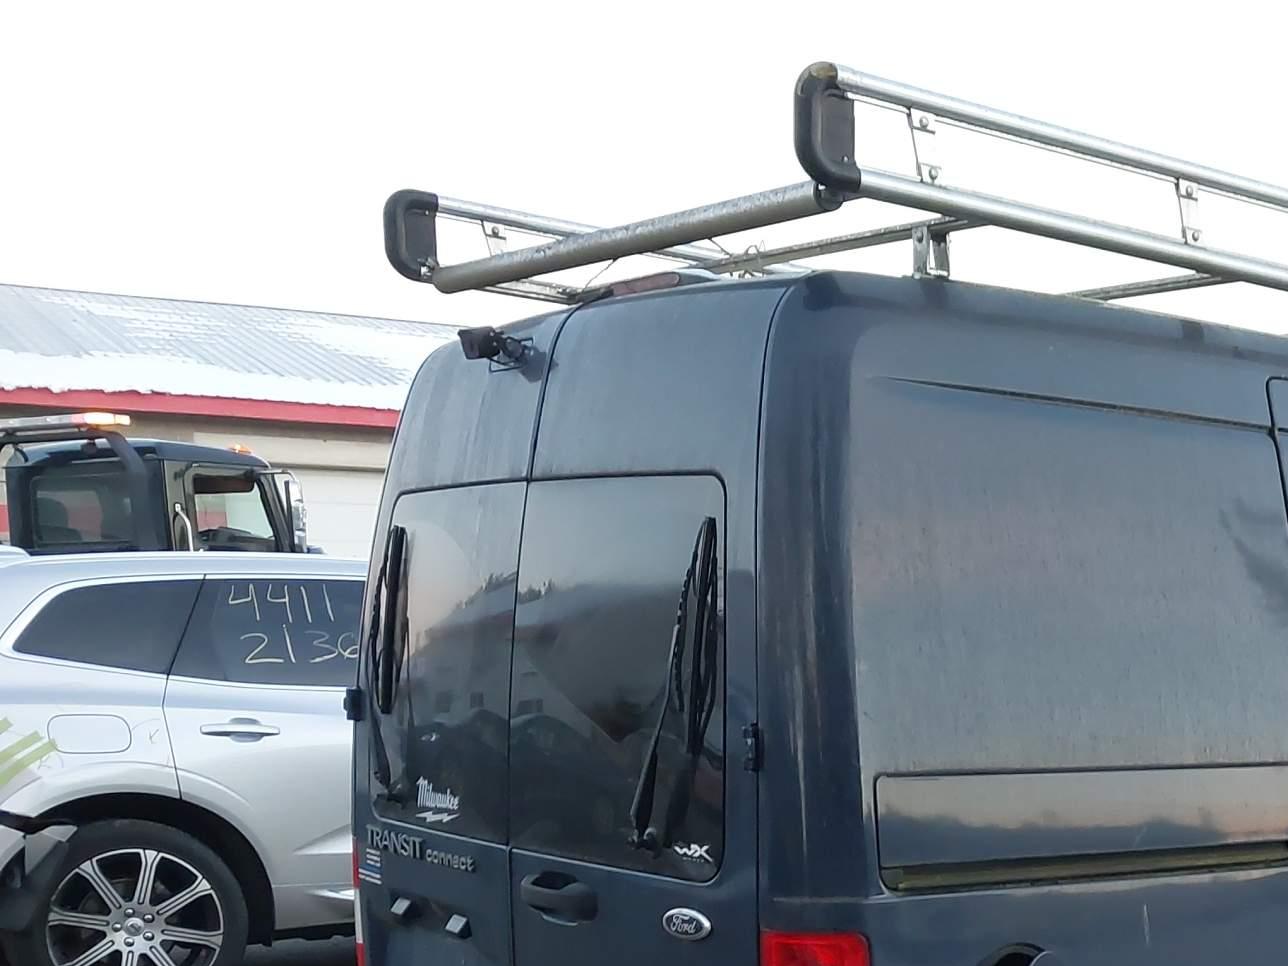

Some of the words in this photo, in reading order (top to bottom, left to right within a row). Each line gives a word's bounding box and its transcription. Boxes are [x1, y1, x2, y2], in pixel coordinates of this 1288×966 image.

[228, 583, 335, 623] 4411
[415, 775, 460, 811] Milwaukee
[365, 823, 424, 859] TRANSIT
[425, 848, 475, 872] connect
